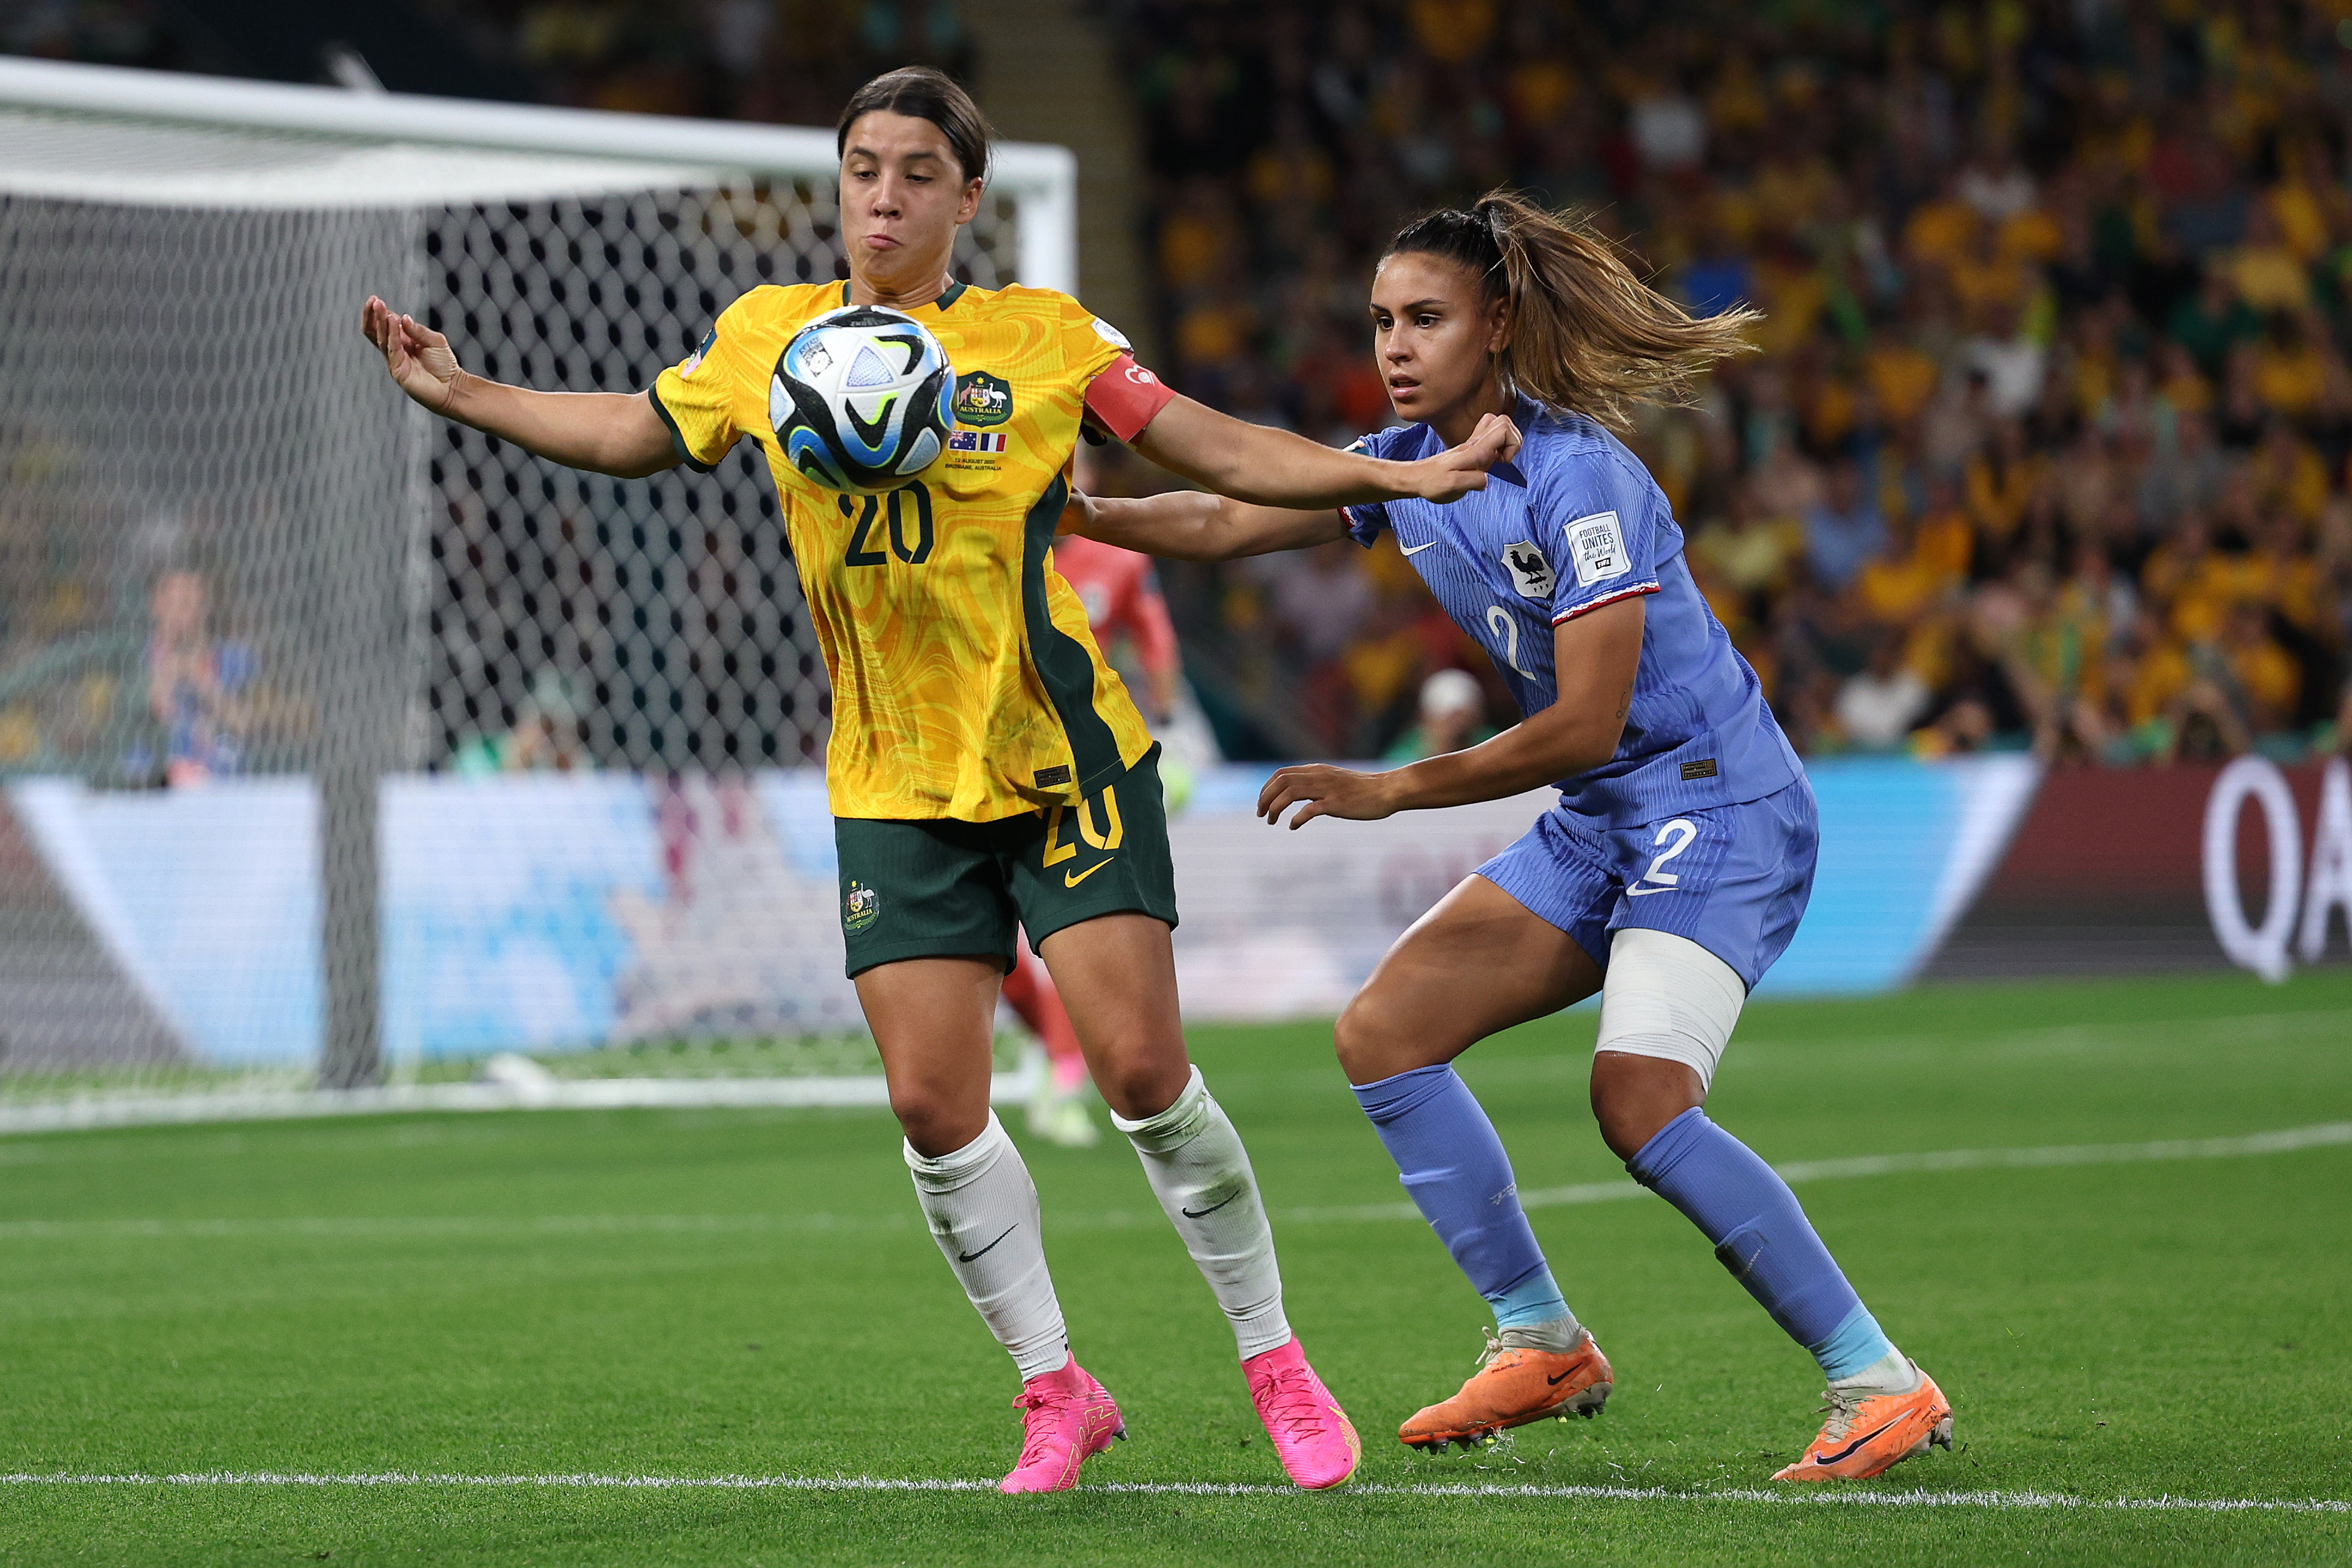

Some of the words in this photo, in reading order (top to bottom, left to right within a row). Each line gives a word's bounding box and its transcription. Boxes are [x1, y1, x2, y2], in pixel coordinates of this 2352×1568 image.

[838, 480, 934, 566] 20
[1579, 524, 1611, 538] FOOTBALL
[1582, 532, 1614, 550] UNITES
[1583, 550, 1597, 561] the
[1596, 544, 1616, 557] World
[1597, 559, 1610, 568] FIFA
[1487, 605, 1537, 681] 2
[1643, 819, 1697, 885] 2
[846, 908, 873, 923] AUSTRALIA
